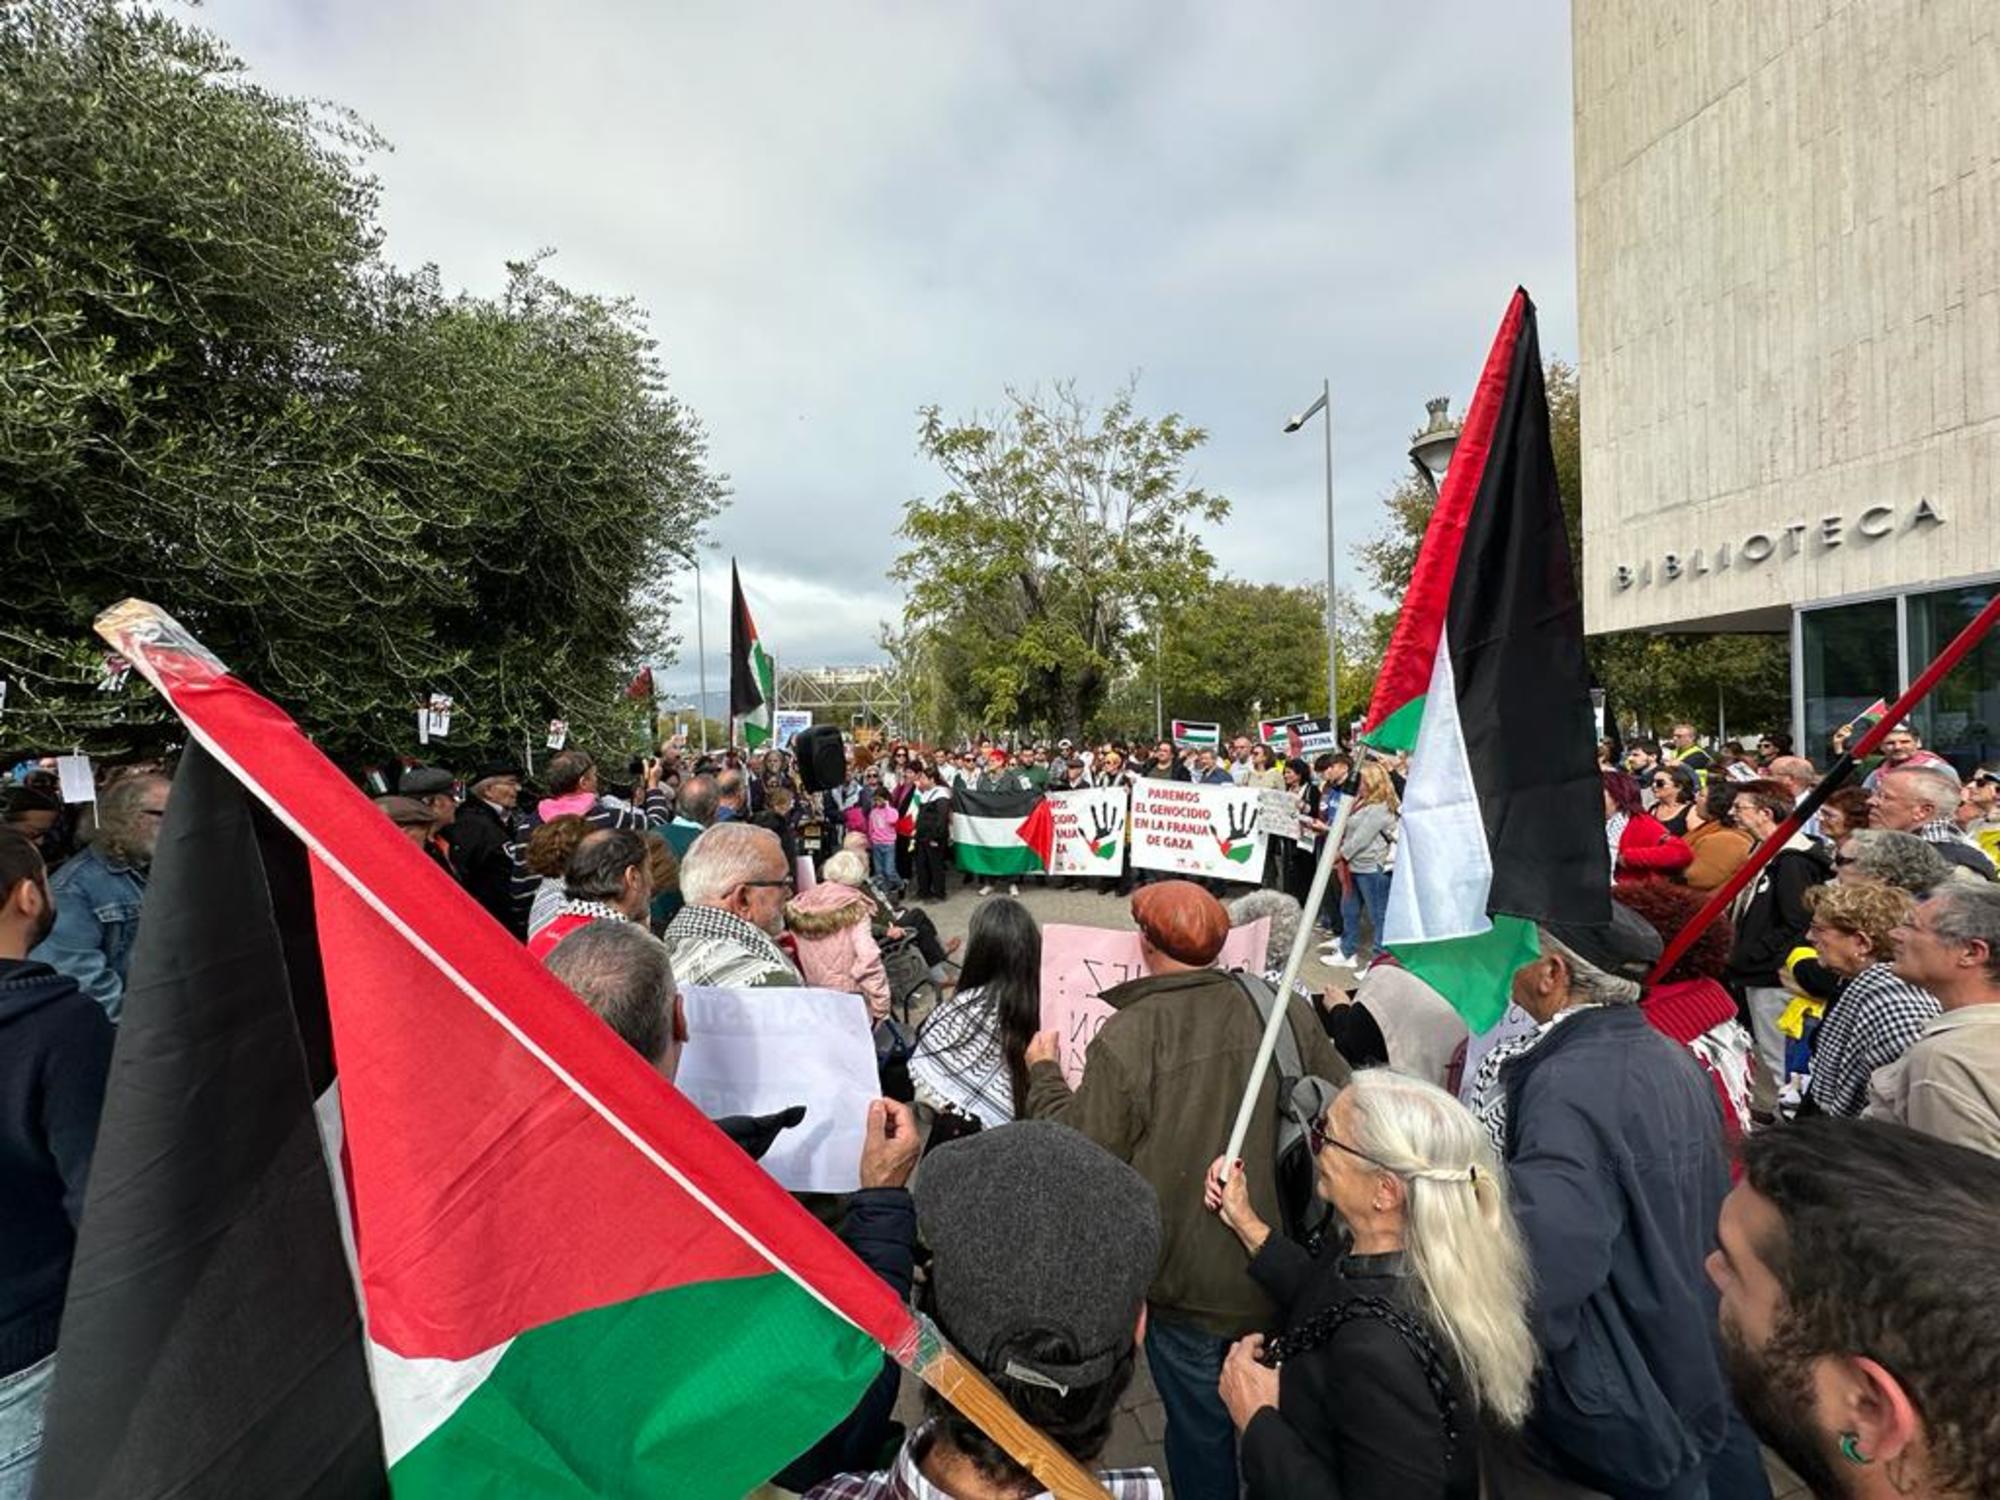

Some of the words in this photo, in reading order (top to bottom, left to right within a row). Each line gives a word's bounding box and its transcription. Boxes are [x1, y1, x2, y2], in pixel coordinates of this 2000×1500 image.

[1614, 496, 1946, 591] BIBLIOTECA
[1147, 788, 1200, 802] PAREMOS
[1135, 802, 1147, 814] EL
[1149, 803, 1212, 820] GENOCIDIO
[1134, 818, 1149, 829] EN
[1151, 819, 1165, 831] LA
[1167, 822, 1209, 836] FRANJA
[1146, 834, 1161, 846] DE
[1163, 837, 1194, 850] GAZA
